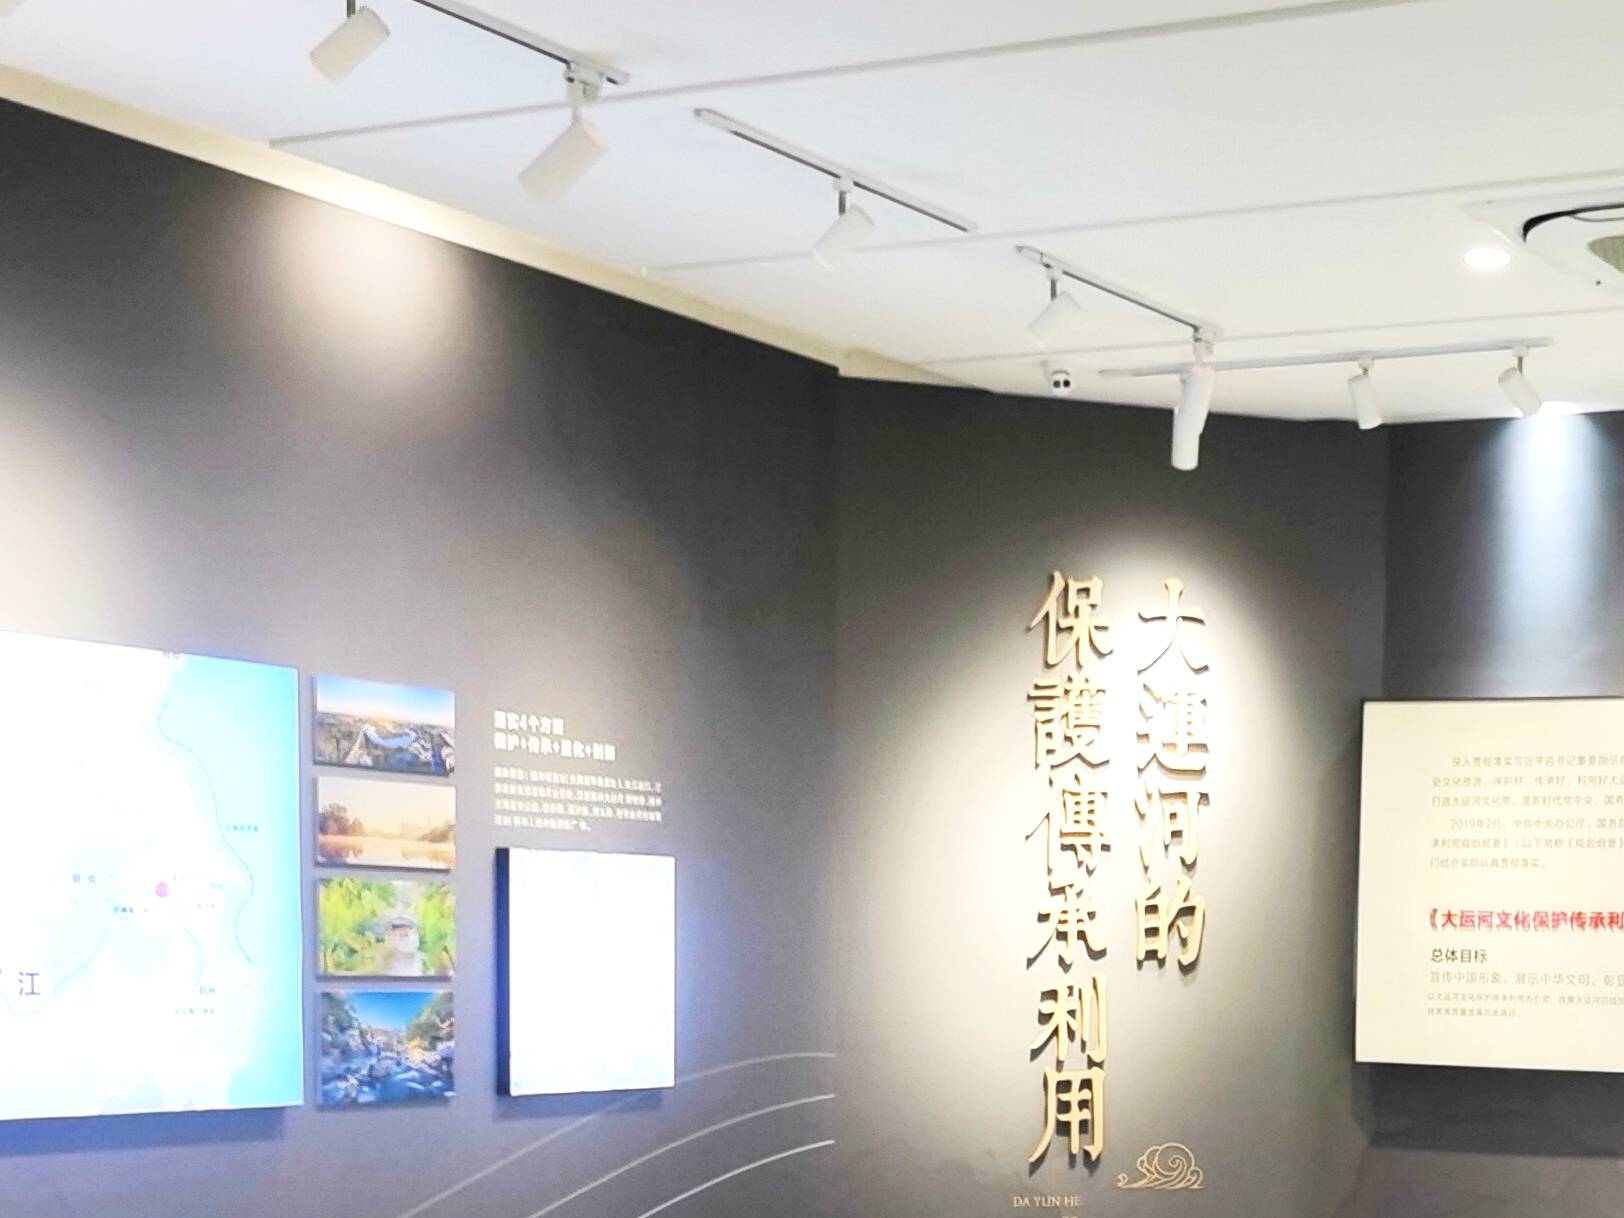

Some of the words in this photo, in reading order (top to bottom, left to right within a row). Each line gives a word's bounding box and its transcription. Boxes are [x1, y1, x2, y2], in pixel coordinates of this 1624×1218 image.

[1134, 576, 1212, 970] 大運河的
[1025, 569, 1114, 1170] 保護傳承利用
[1429, 947, 1488, 964] 总体目标
[18, 971, 41, 997] 江
[1013, 1195, 1030, 1207] DA
[1033, 1195, 1060, 1207] YUN
